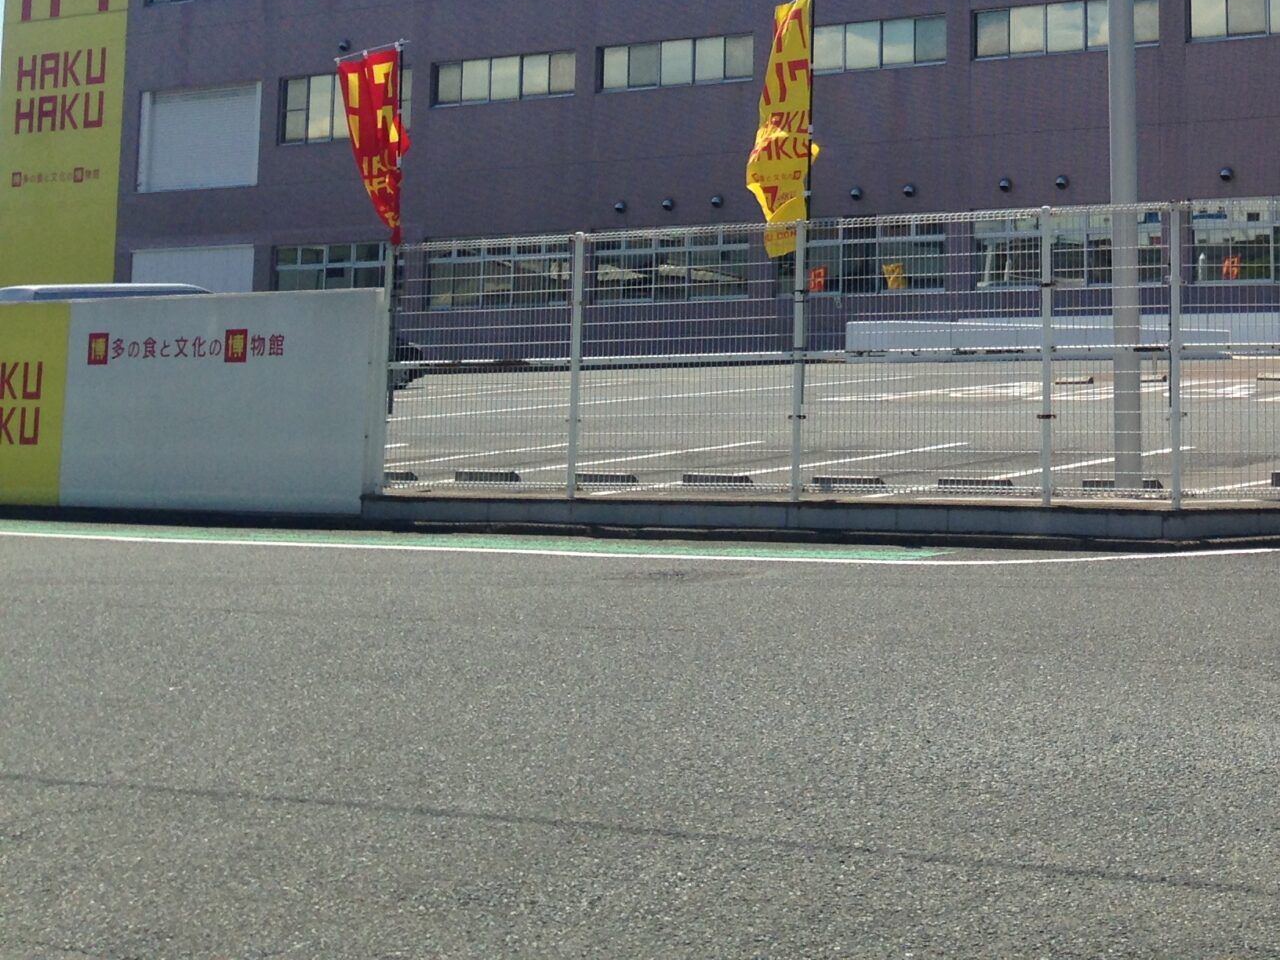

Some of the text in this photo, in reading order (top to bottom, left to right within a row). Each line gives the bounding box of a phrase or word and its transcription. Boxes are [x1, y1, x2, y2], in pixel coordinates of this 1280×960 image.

[17, 48, 107, 91] HAKU
[14, 91, 104, 134] HAKU
[87, 328, 285, 365] 博多の食と文化の博物館
